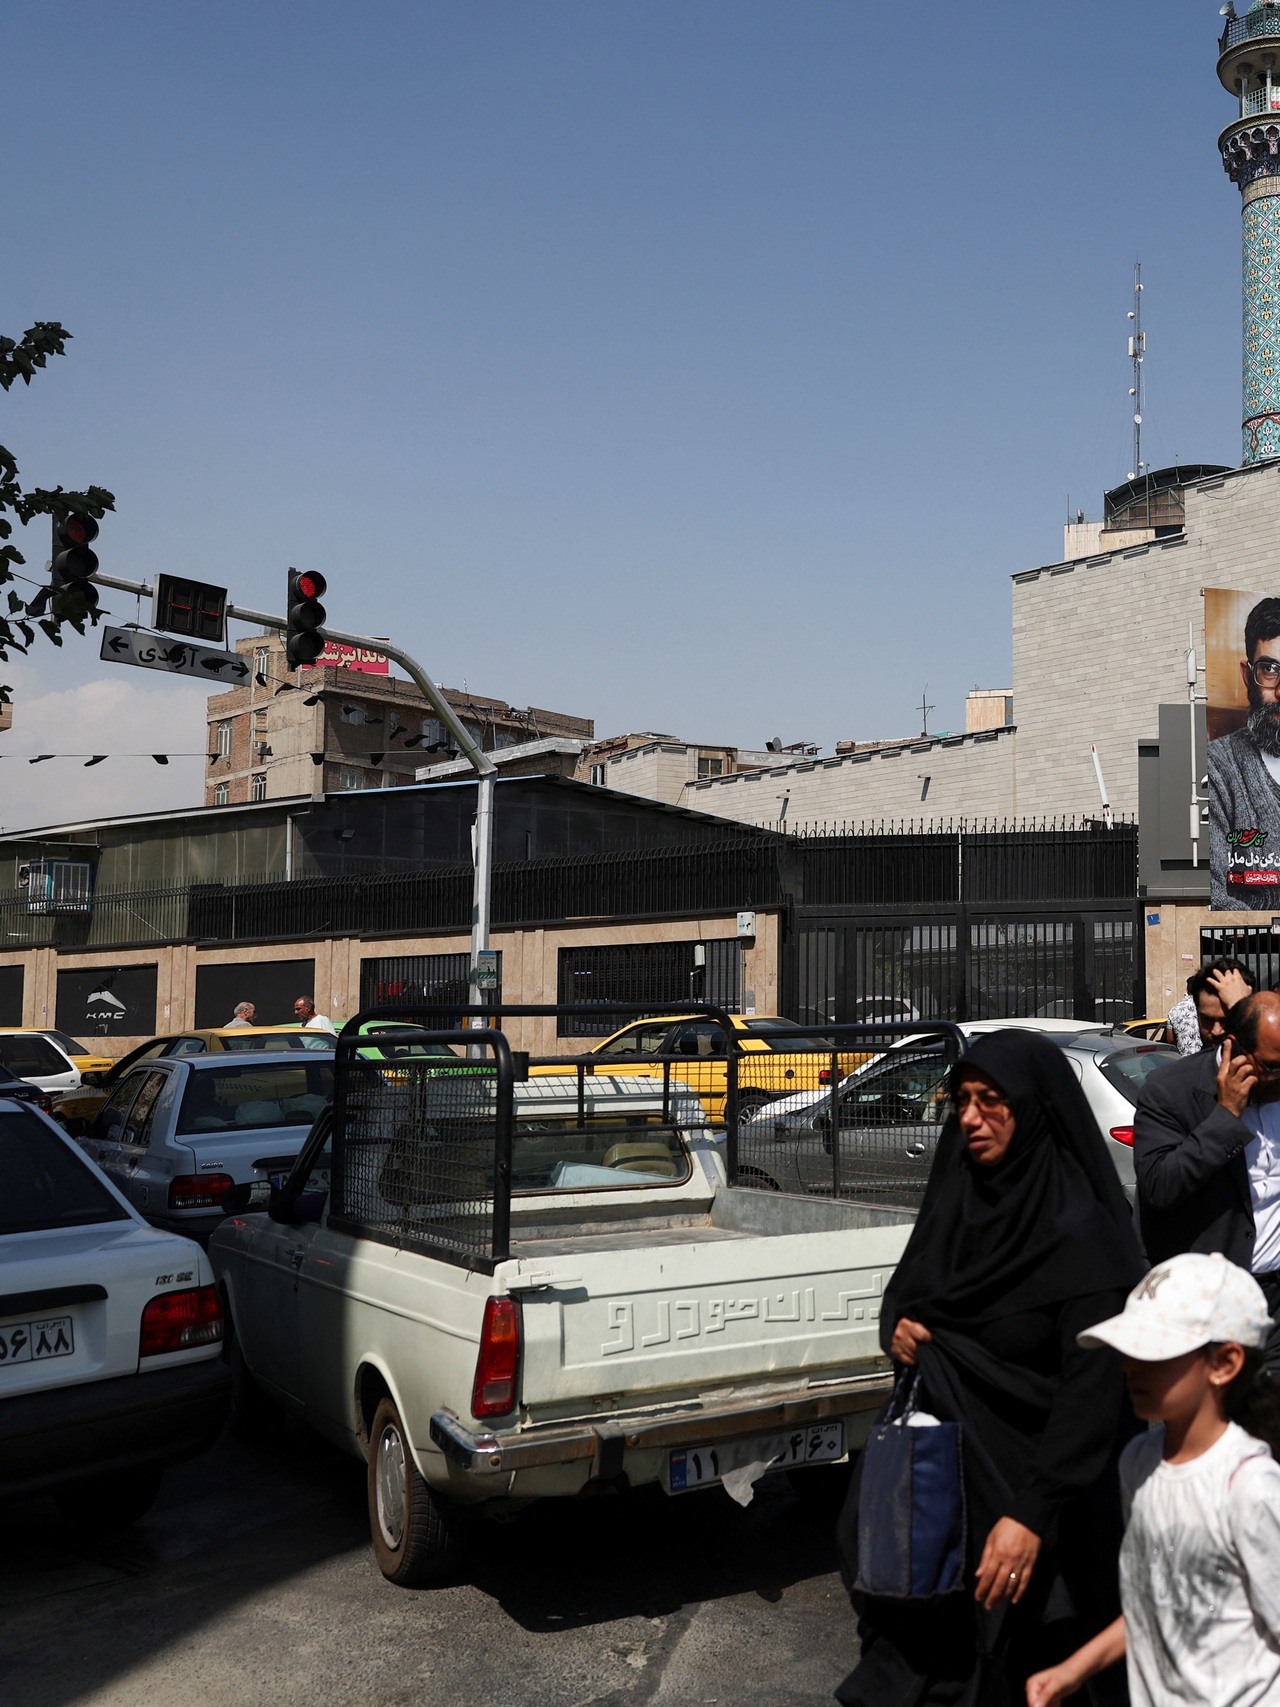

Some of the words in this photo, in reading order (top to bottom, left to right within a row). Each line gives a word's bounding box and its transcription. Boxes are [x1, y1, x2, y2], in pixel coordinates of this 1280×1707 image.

[138, 647, 200, 669] آزدی
[1227, 851, 1235, 868] را
[1234, 852, 1245, 864] ما
[1245, 852, 1260, 867] دل
[1260, 852, 1275, 868] کن
[176, 1271, 193, 1282] SE
[763, 1272, 884, 1322] یران
[36, 1328, 70, 1356] ۸۸
[808, 1434, 838, 1459] ۶۰
